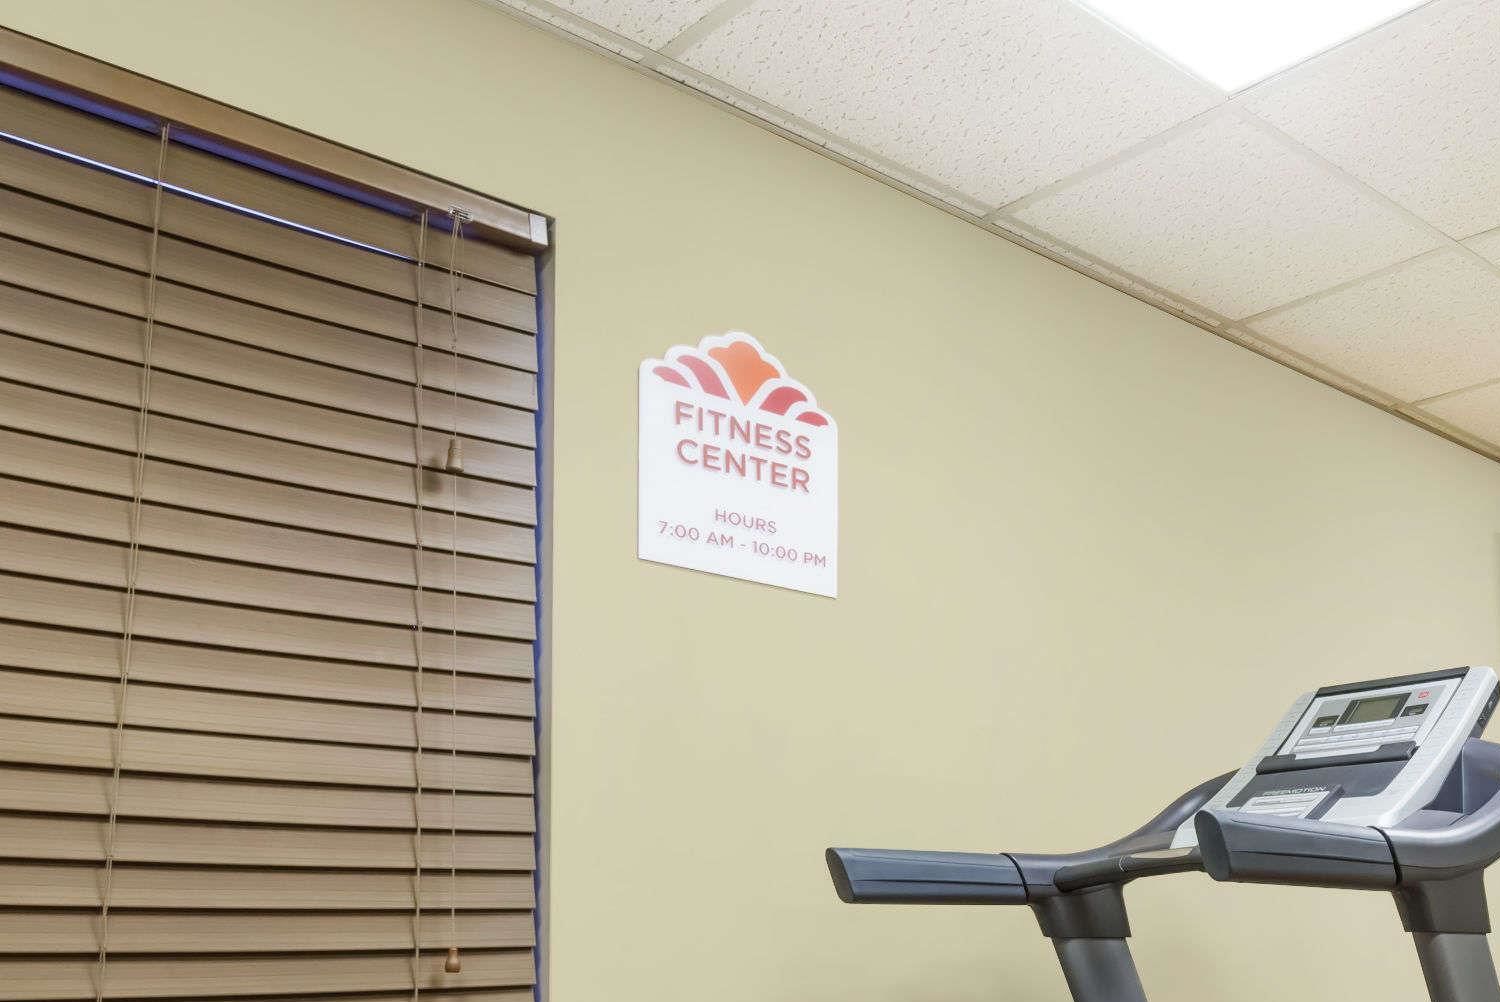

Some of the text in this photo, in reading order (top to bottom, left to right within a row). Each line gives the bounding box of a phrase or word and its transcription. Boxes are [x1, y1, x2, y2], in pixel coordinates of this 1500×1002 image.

[673, 400, 813, 460] FITNESS
[675, 438, 811, 494] CENTER
[658, 520, 700, 542] 7:00
[706, 531, 734, 550] AM
[752, 540, 799, 562] 10:00
[803, 552, 827, 568] PM
[714, 508, 777, 534] HOURS
